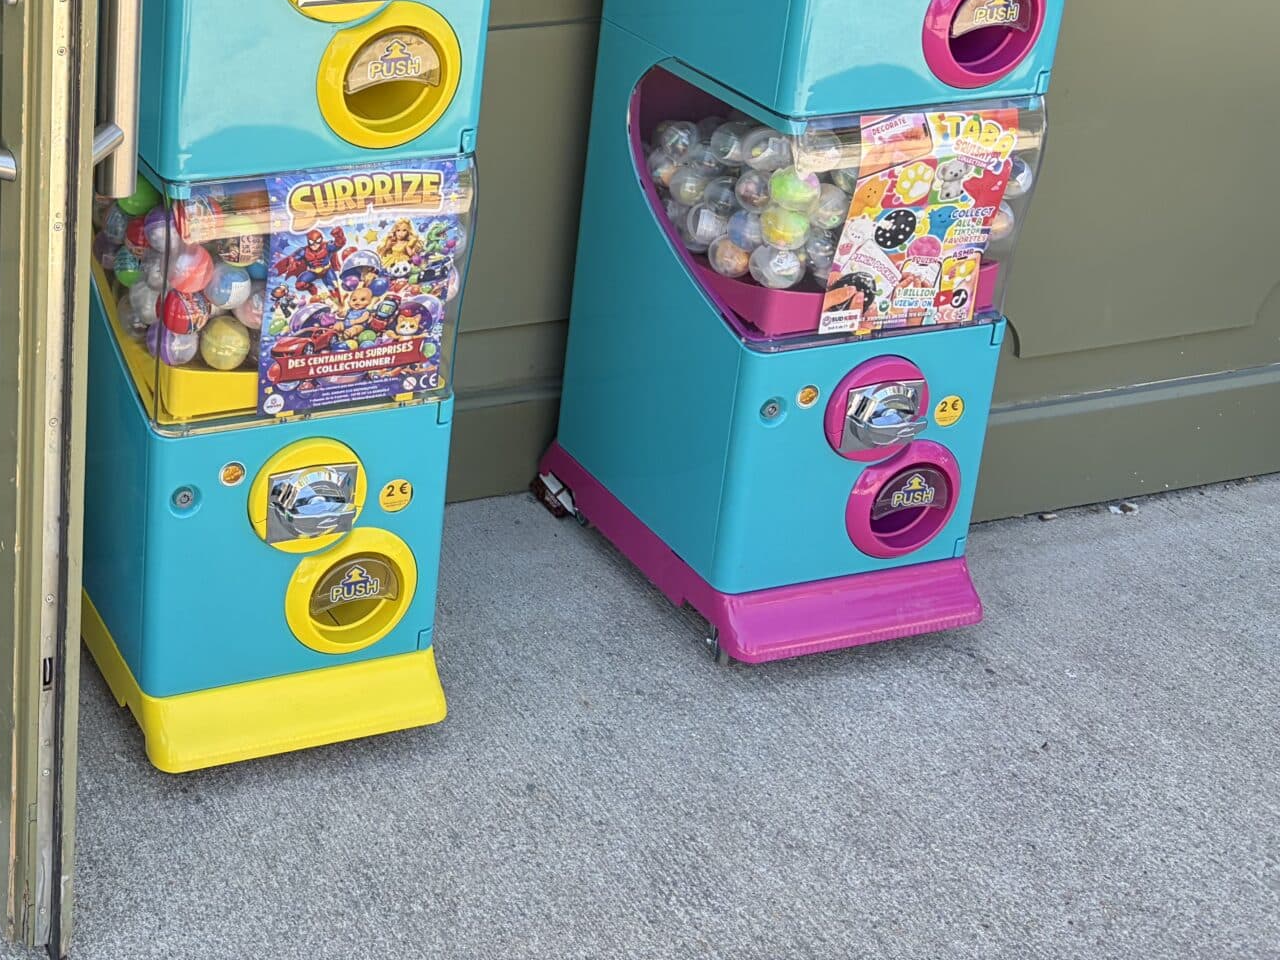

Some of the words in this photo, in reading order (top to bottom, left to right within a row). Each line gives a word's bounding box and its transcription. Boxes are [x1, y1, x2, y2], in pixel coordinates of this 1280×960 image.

[974, 4, 1020, 25] PUSH
[368, 57, 421, 80] PUSH
[871, 117, 908, 136] DECORATE
[289, 172, 442, 218] SURPRIZE
[952, 207, 994, 218] COLLECT
[952, 248, 975, 258] ASMR
[902, 288, 936, 297] BILLION
[894, 299, 919, 307] VIEWS
[287, 357, 307, 370] DES
[308, 352, 354, 367] CENTAINES
[354, 351, 364, 360] DE
[366, 340, 414, 359] SURPRISES
[940, 400, 948, 413] 2
[951, 399, 959, 411] €
[386, 484, 395, 498] 2
[399, 482, 408, 495] €
[891, 489, 934, 508] PUSH
[330, 579, 381, 602] PUSH
